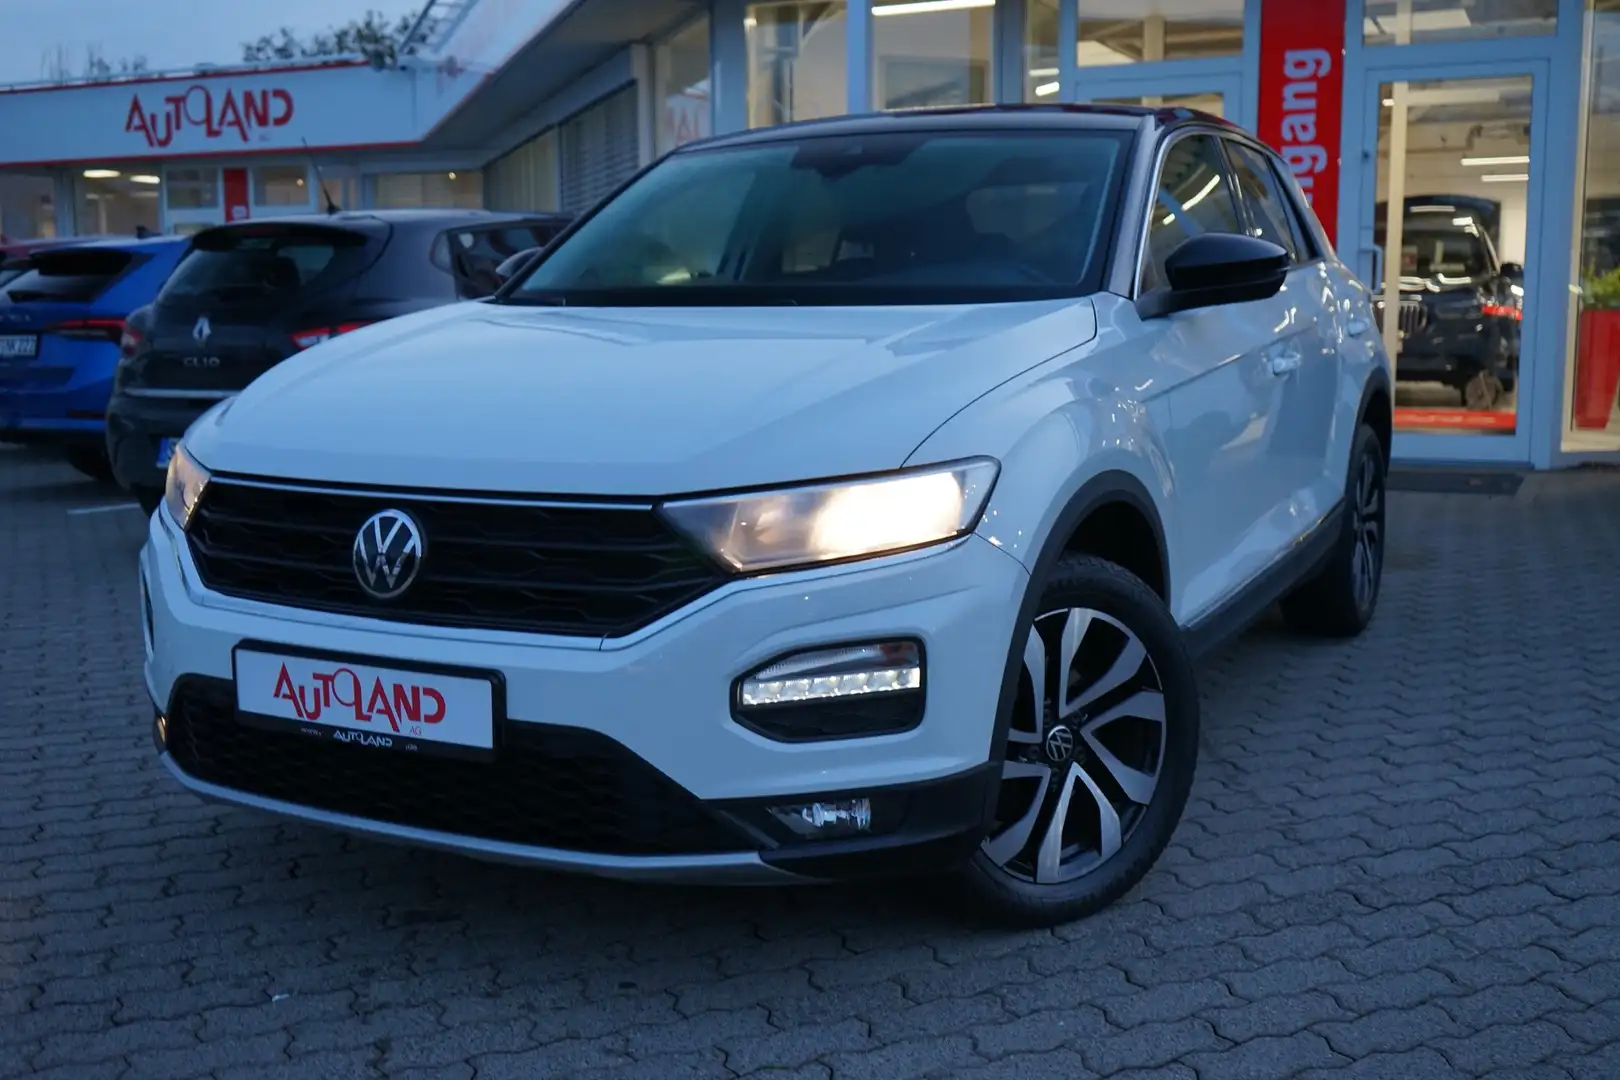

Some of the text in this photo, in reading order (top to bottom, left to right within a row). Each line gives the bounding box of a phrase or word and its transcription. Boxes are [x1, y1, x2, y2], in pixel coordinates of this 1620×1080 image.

[125, 84, 294, 147] AUTOLAND
[183, 356, 221, 367] CLIO
[273, 662, 446, 733] AUTOLAND
[333, 730, 393, 748] AUTOLAND
